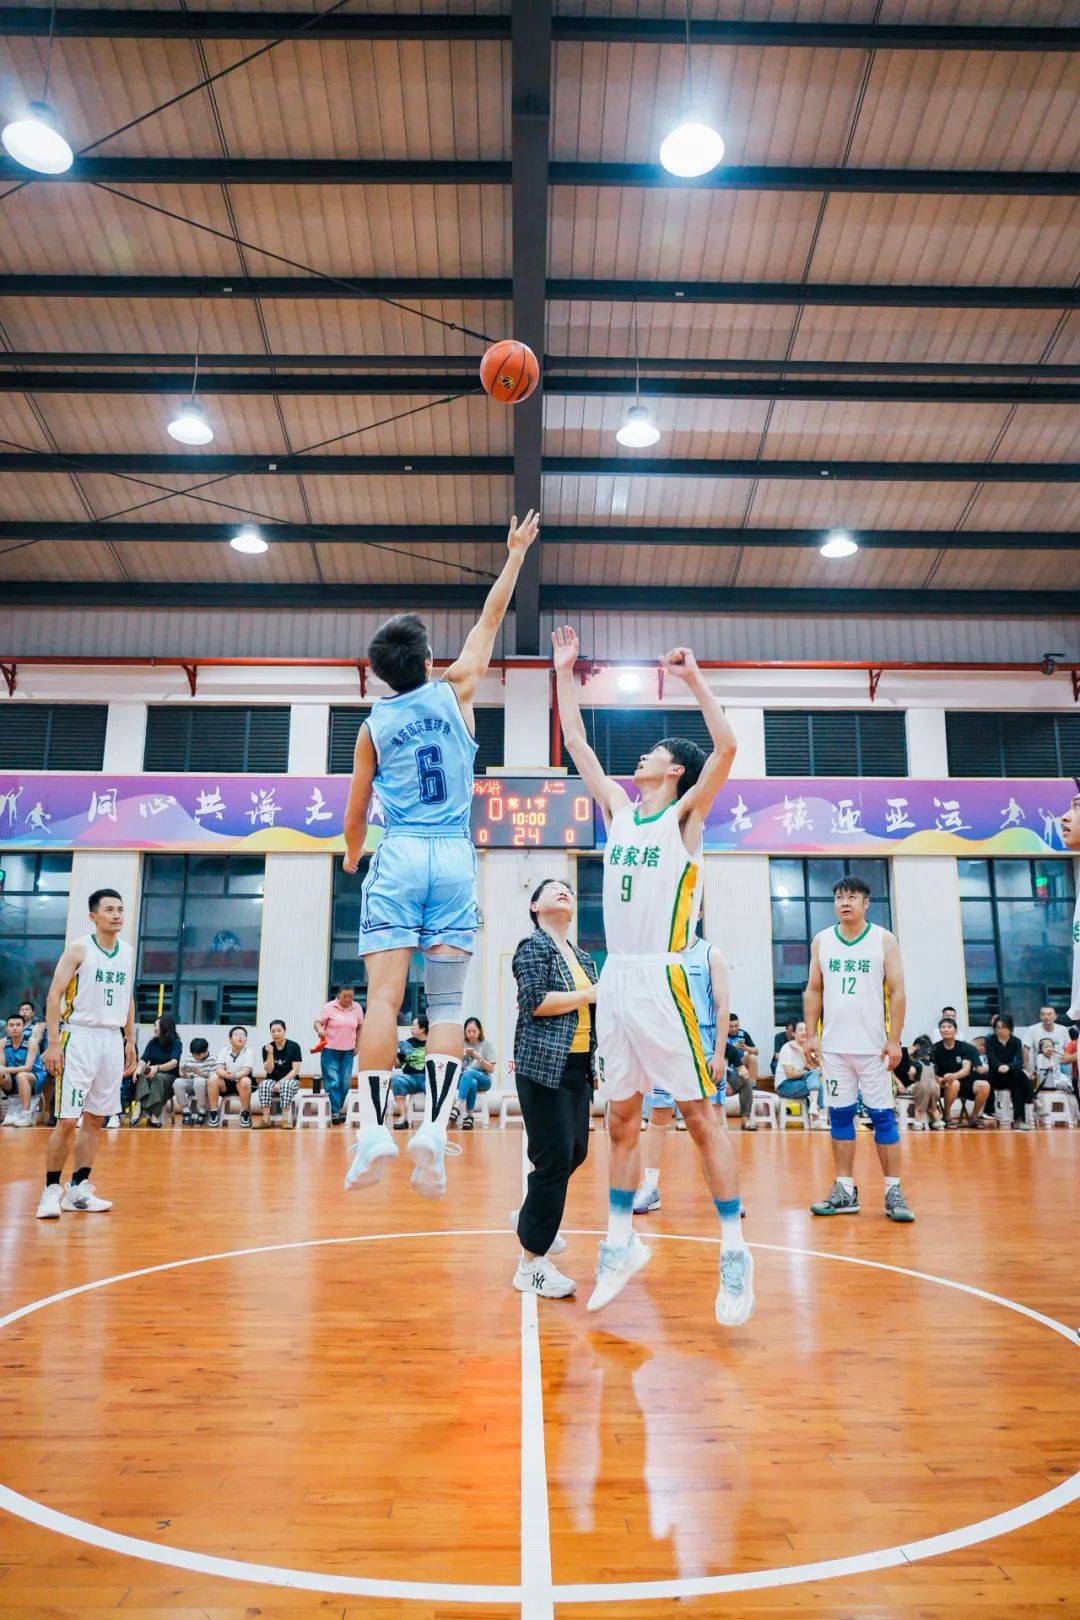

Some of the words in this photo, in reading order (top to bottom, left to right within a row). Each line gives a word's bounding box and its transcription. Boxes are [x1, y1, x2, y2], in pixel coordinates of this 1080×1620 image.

[414, 743, 448, 806] 6
[489, 797, 502, 820] 0
[575, 797, 589, 820] 0
[512, 813, 545, 825] 10:00
[479, 829, 488, 843] 0
[513, 827, 541, 846] 24
[566, 829, 574, 843] 0
[609, 843, 661, 868] 楼家塔
[621, 874, 633, 902] 9
[829, 958, 871, 974] 楼家塔
[841, 977, 857, 995] 12
[826, 1079, 838, 1097] 12
